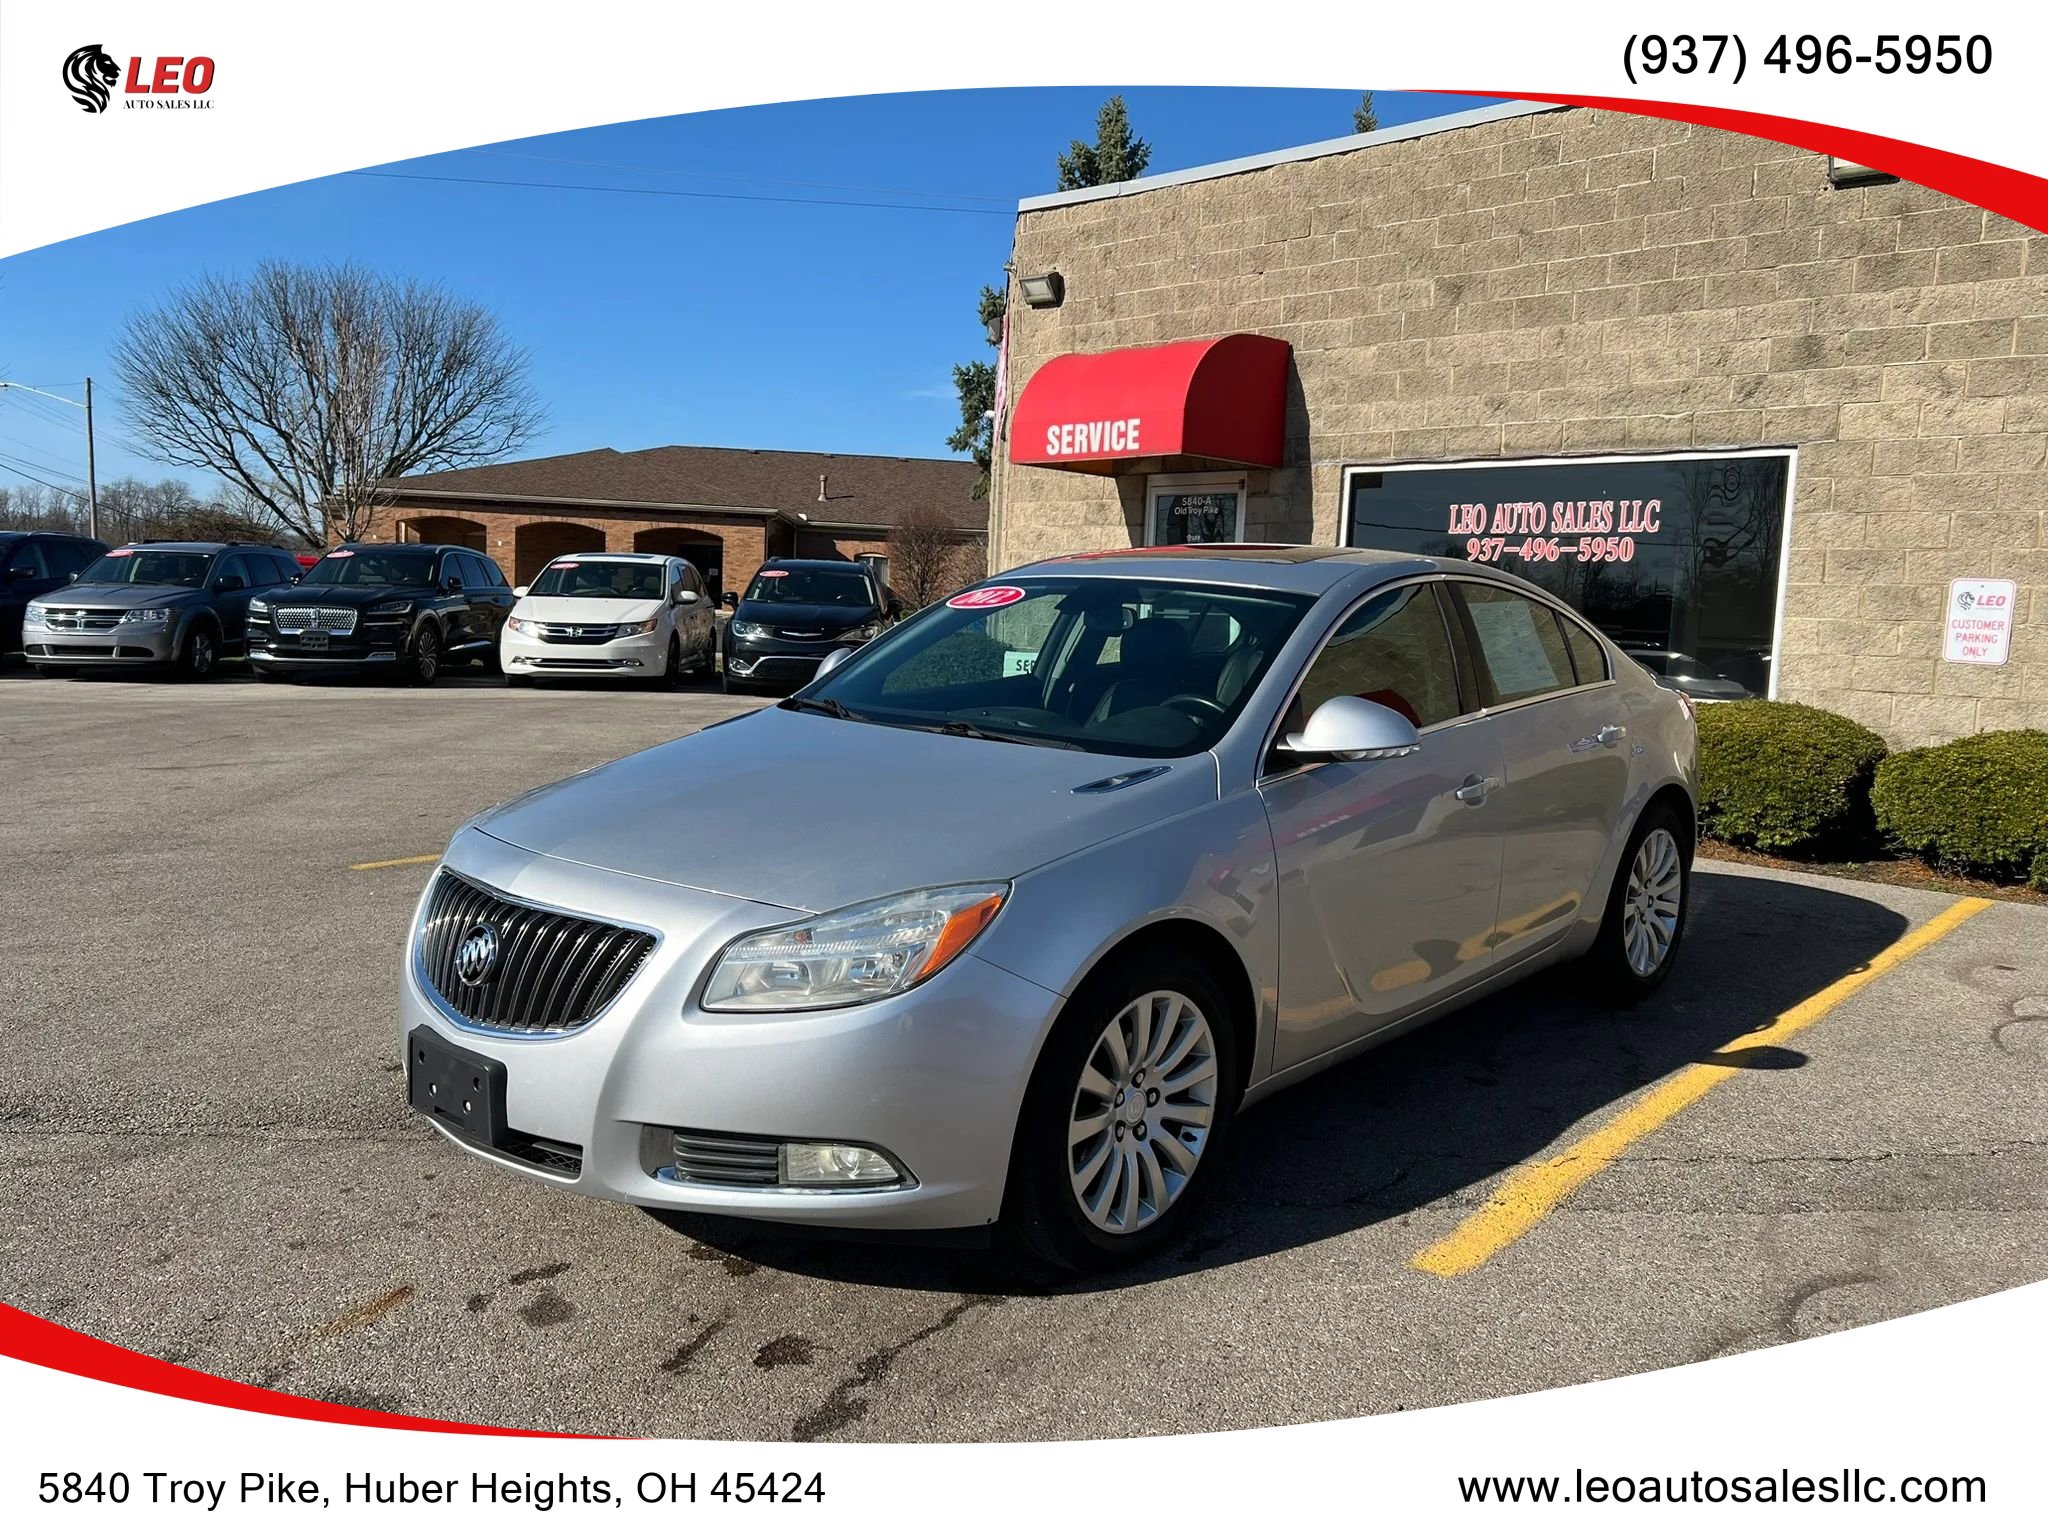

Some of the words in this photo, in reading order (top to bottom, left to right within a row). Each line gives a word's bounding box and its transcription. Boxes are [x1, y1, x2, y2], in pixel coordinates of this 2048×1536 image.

[1046, 418, 1140, 456] SERVICE
[1182, 497, 1211, 505] 5840-A
[1174, 506, 1187, 514] Old
[1188, 506, 1202, 516] Troy
[1448, 503, 1487, 534] LEO
[1491, 501, 1547, 534] AUTO
[1551, 500, 1614, 533] SALES
[1617, 499, 1661, 533] LLC
[1466, 536, 1635, 562] 937-496-5950
[1976, 595, 2006, 606] LEO
[1951, 619, 2005, 631] CUSTOMER
[1955, 632, 1999, 644] PARKING
[1962, 646, 1988, 657] ONLY
